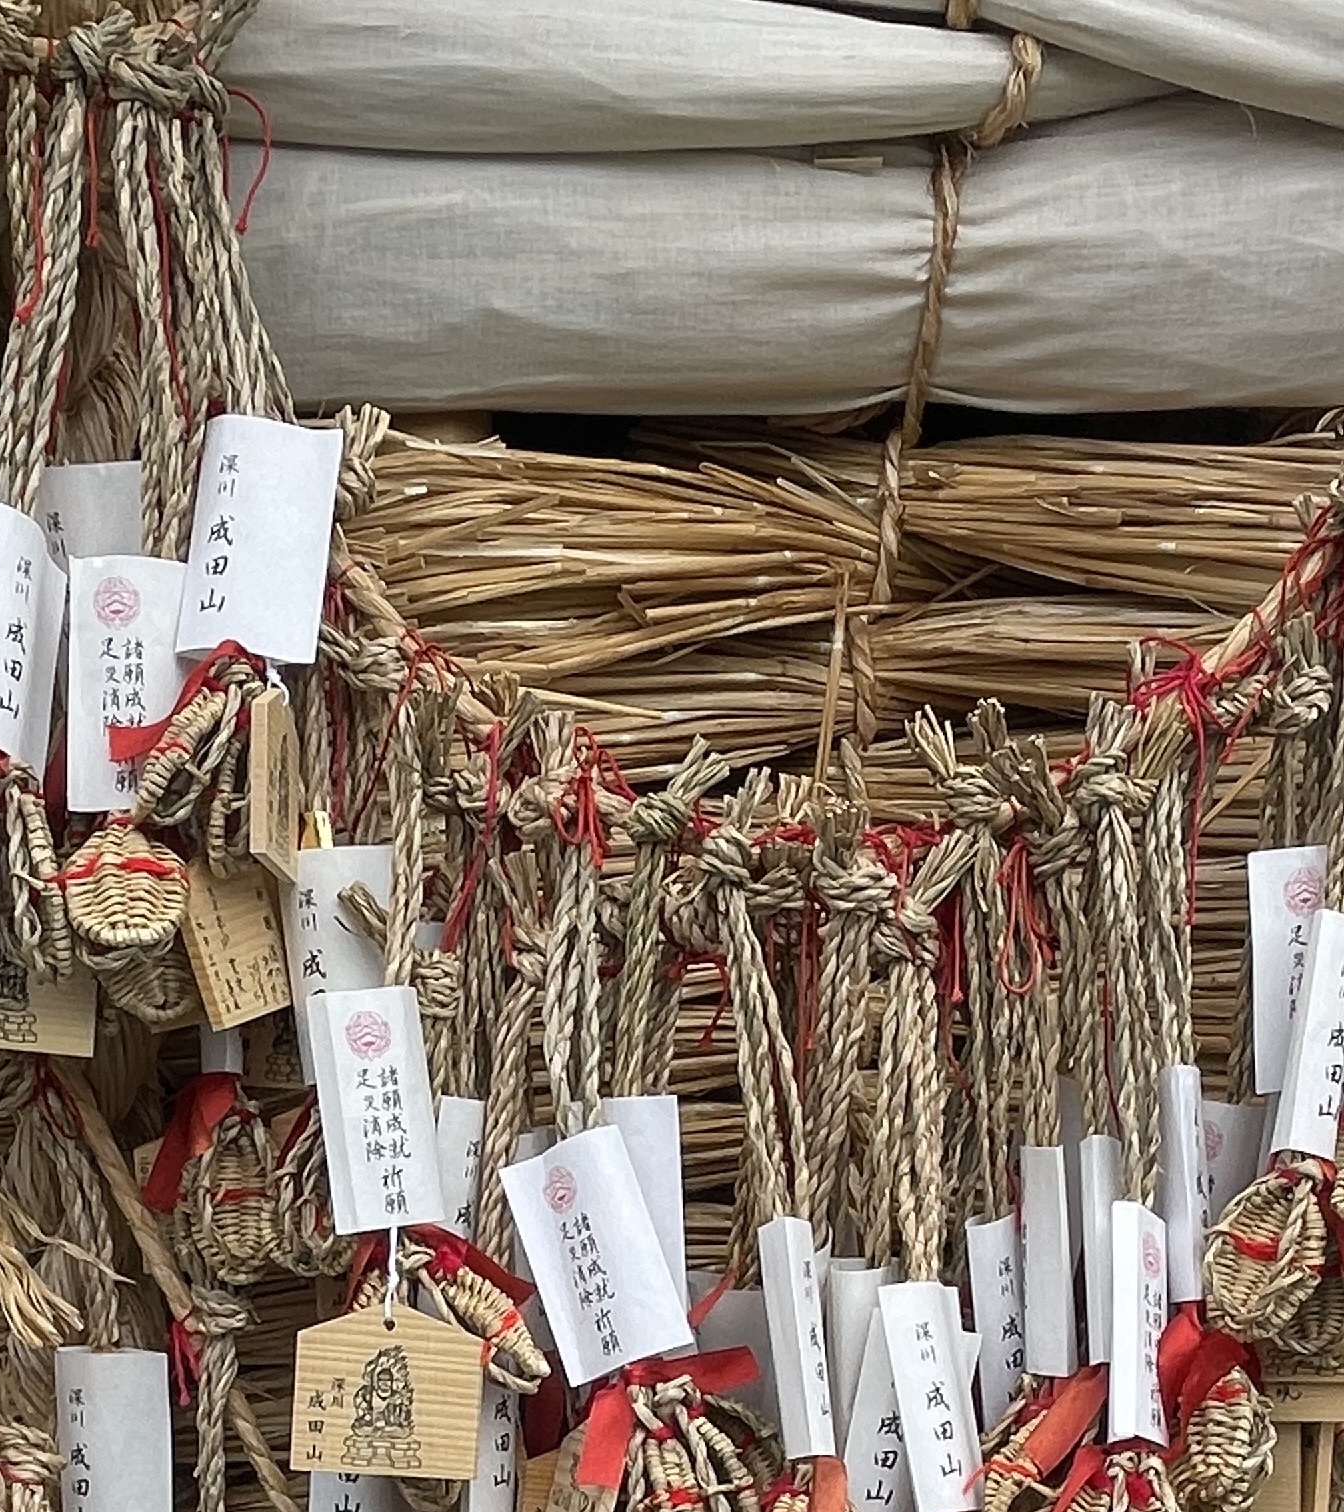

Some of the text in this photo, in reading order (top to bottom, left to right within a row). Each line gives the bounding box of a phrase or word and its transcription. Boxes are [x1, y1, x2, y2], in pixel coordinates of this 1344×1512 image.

[199, 516, 234, 613] 成田山
[0, 618, 28, 719] 成田山
[382, 1168, 409, 1216] 祈願
[594, 1308, 621, 1354] 祈願
[1002, 1315, 1024, 1402] 成田
[306, 1390, 326, 1462] 成田山
[493, 1395, 510, 1487] 成田山
[866, 1411, 902, 1505] 成田山
[925, 1383, 962, 1478] 成田山
